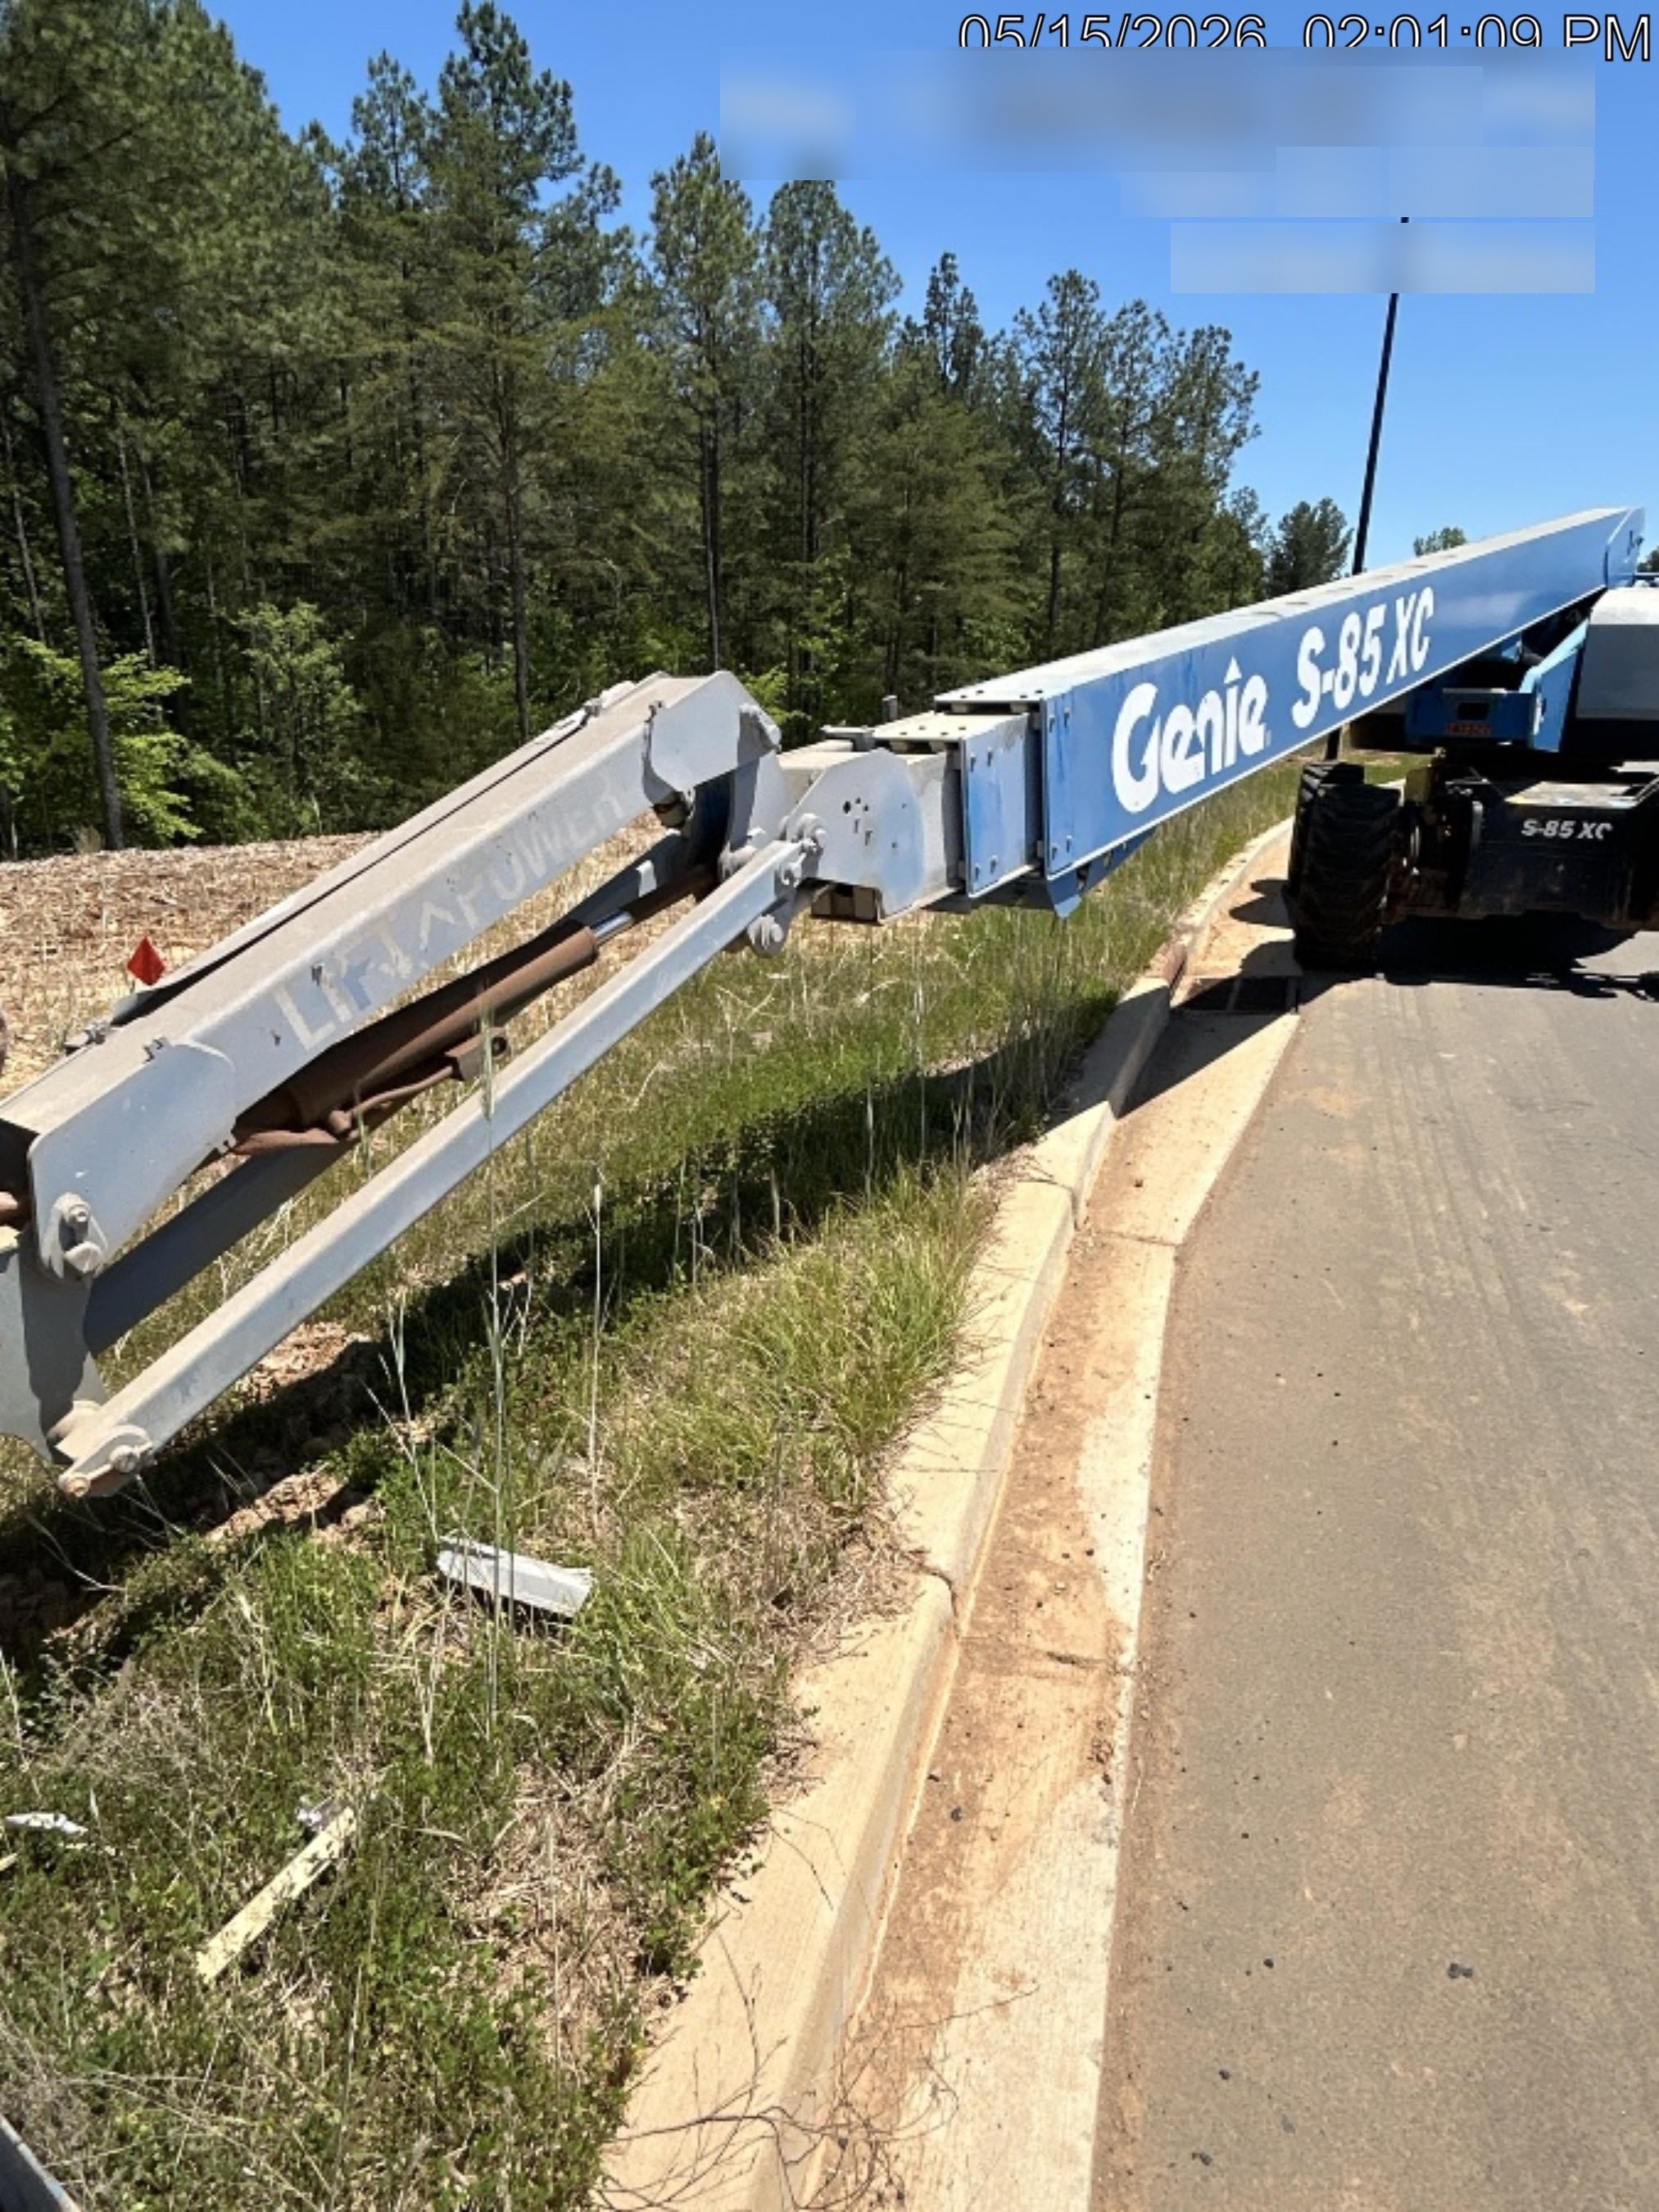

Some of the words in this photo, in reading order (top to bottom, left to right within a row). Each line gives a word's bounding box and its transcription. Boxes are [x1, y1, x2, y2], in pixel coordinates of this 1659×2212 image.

[1111, 655, 1268, 814] Genie
[1291, 603, 1387, 729] S-85
[1385, 586, 1435, 686] XC
[1520, 817, 1577, 840] S-85
[1575, 820, 1615, 842] XC
